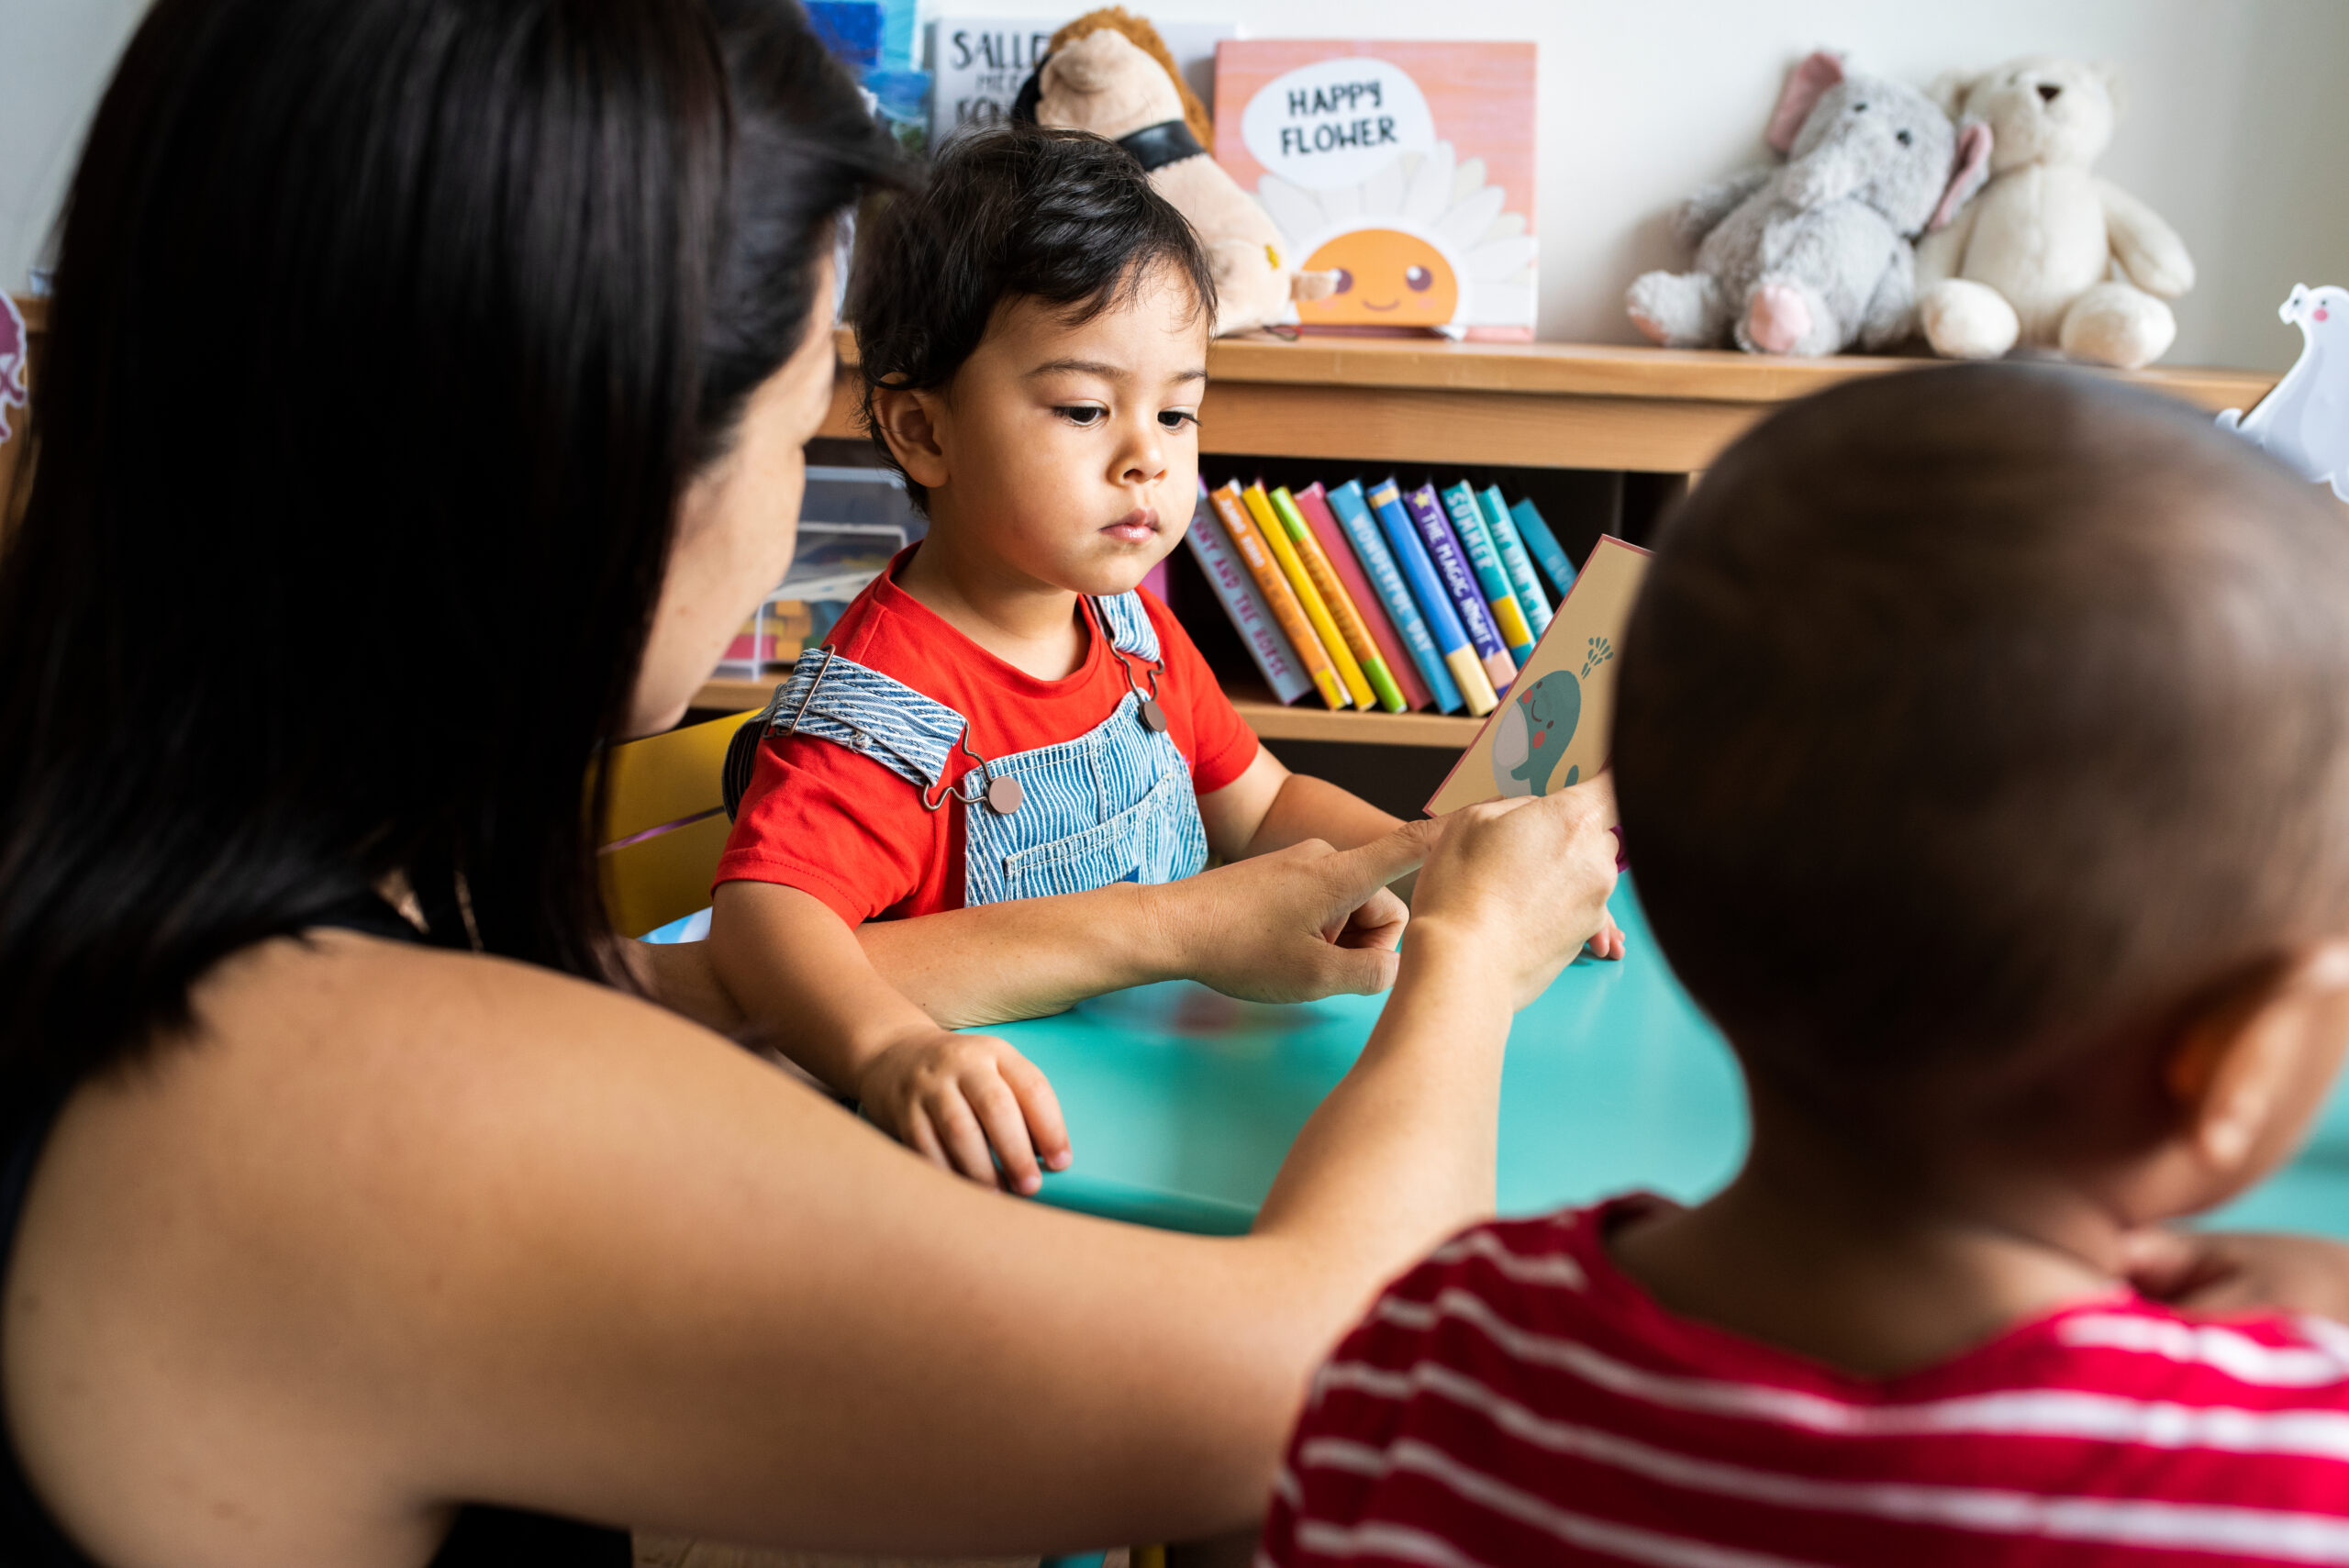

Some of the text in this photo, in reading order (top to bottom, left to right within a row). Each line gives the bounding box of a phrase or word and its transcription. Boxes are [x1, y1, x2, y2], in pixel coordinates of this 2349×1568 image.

[1280, 115, 1399, 156] FLOWER
[1288, 79, 1383, 117] HAPPY
[1348, 511, 1436, 655] WONDERFUL DAY
[1421, 511, 1493, 647] THE MAGIC NIGHT
[1444, 489, 1495, 573] SUMMER
[1211, 555, 1242, 592] AND
[1232, 593, 1261, 625] THE
[1251, 626, 1290, 679] HORSE
